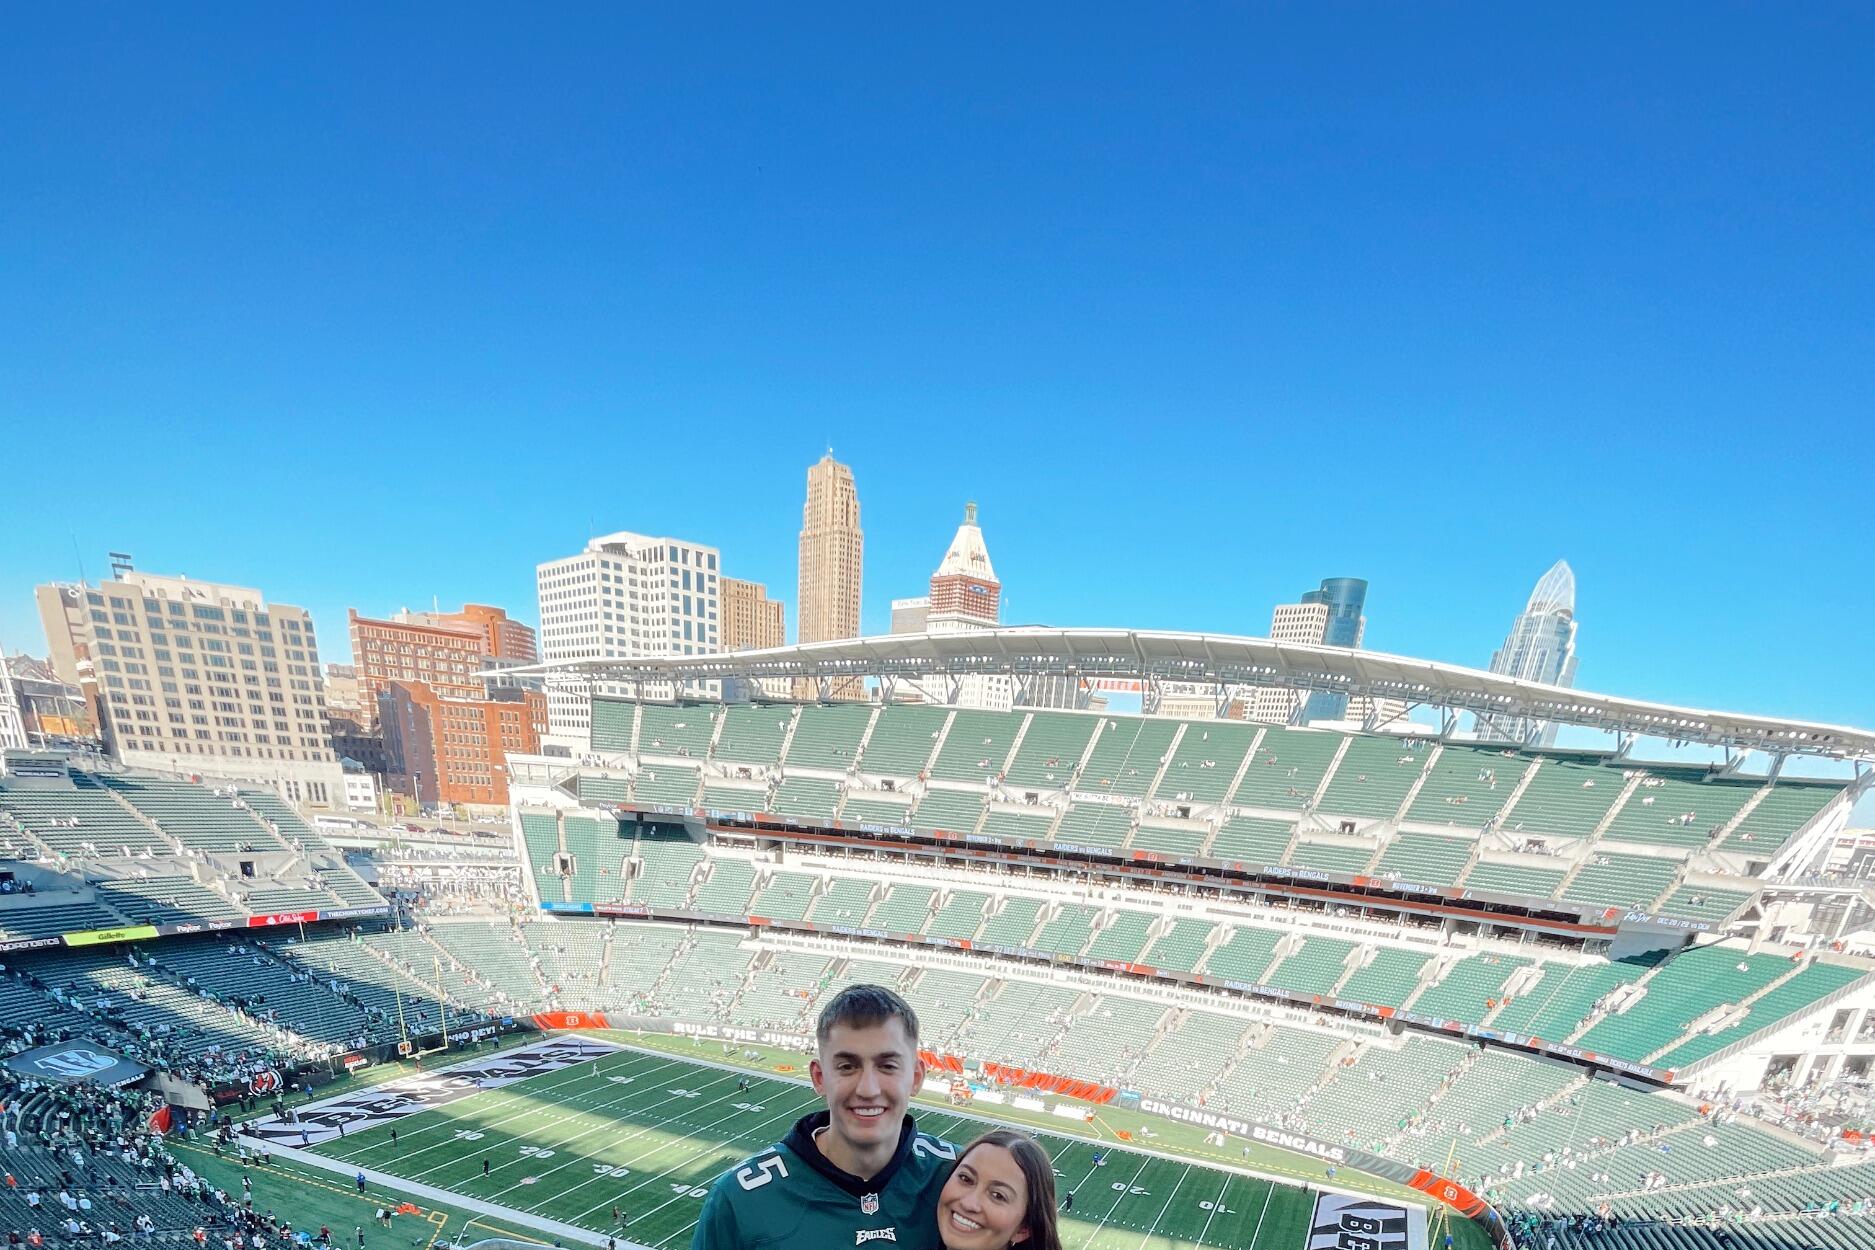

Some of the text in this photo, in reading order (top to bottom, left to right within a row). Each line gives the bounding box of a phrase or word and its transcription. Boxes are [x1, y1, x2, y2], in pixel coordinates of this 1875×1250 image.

[859, 823, 883, 833] RAIDERS
[889, 826, 915, 836] BENGALS
[1053, 843, 1079, 852] RAIDERS
[1086, 846, 1113, 857] BENGALS
[1262, 866, 1291, 876] RAIDERS
[1299, 869, 1330, 881] BENGALS
[832, 925, 856, 935] RAIDERS
[1224, 979, 1251, 991] RAIDERS
[1259, 985, 1290, 998] BENGALS
[471, 1026, 496, 1039] DEY!
[673, 1022, 718, 1037] RULE
[722, 1027, 757, 1041] THE
[305, 1048, 583, 1129] BENGALS
[1140, 1099, 1345, 1161] CINCINNATI BENGALS
[520, 1145, 556, 1159] 20
[593, 1163, 630, 1178] 30
[671, 1183, 709, 1198] 40
[855, 1227, 897, 1246] EAGLES
